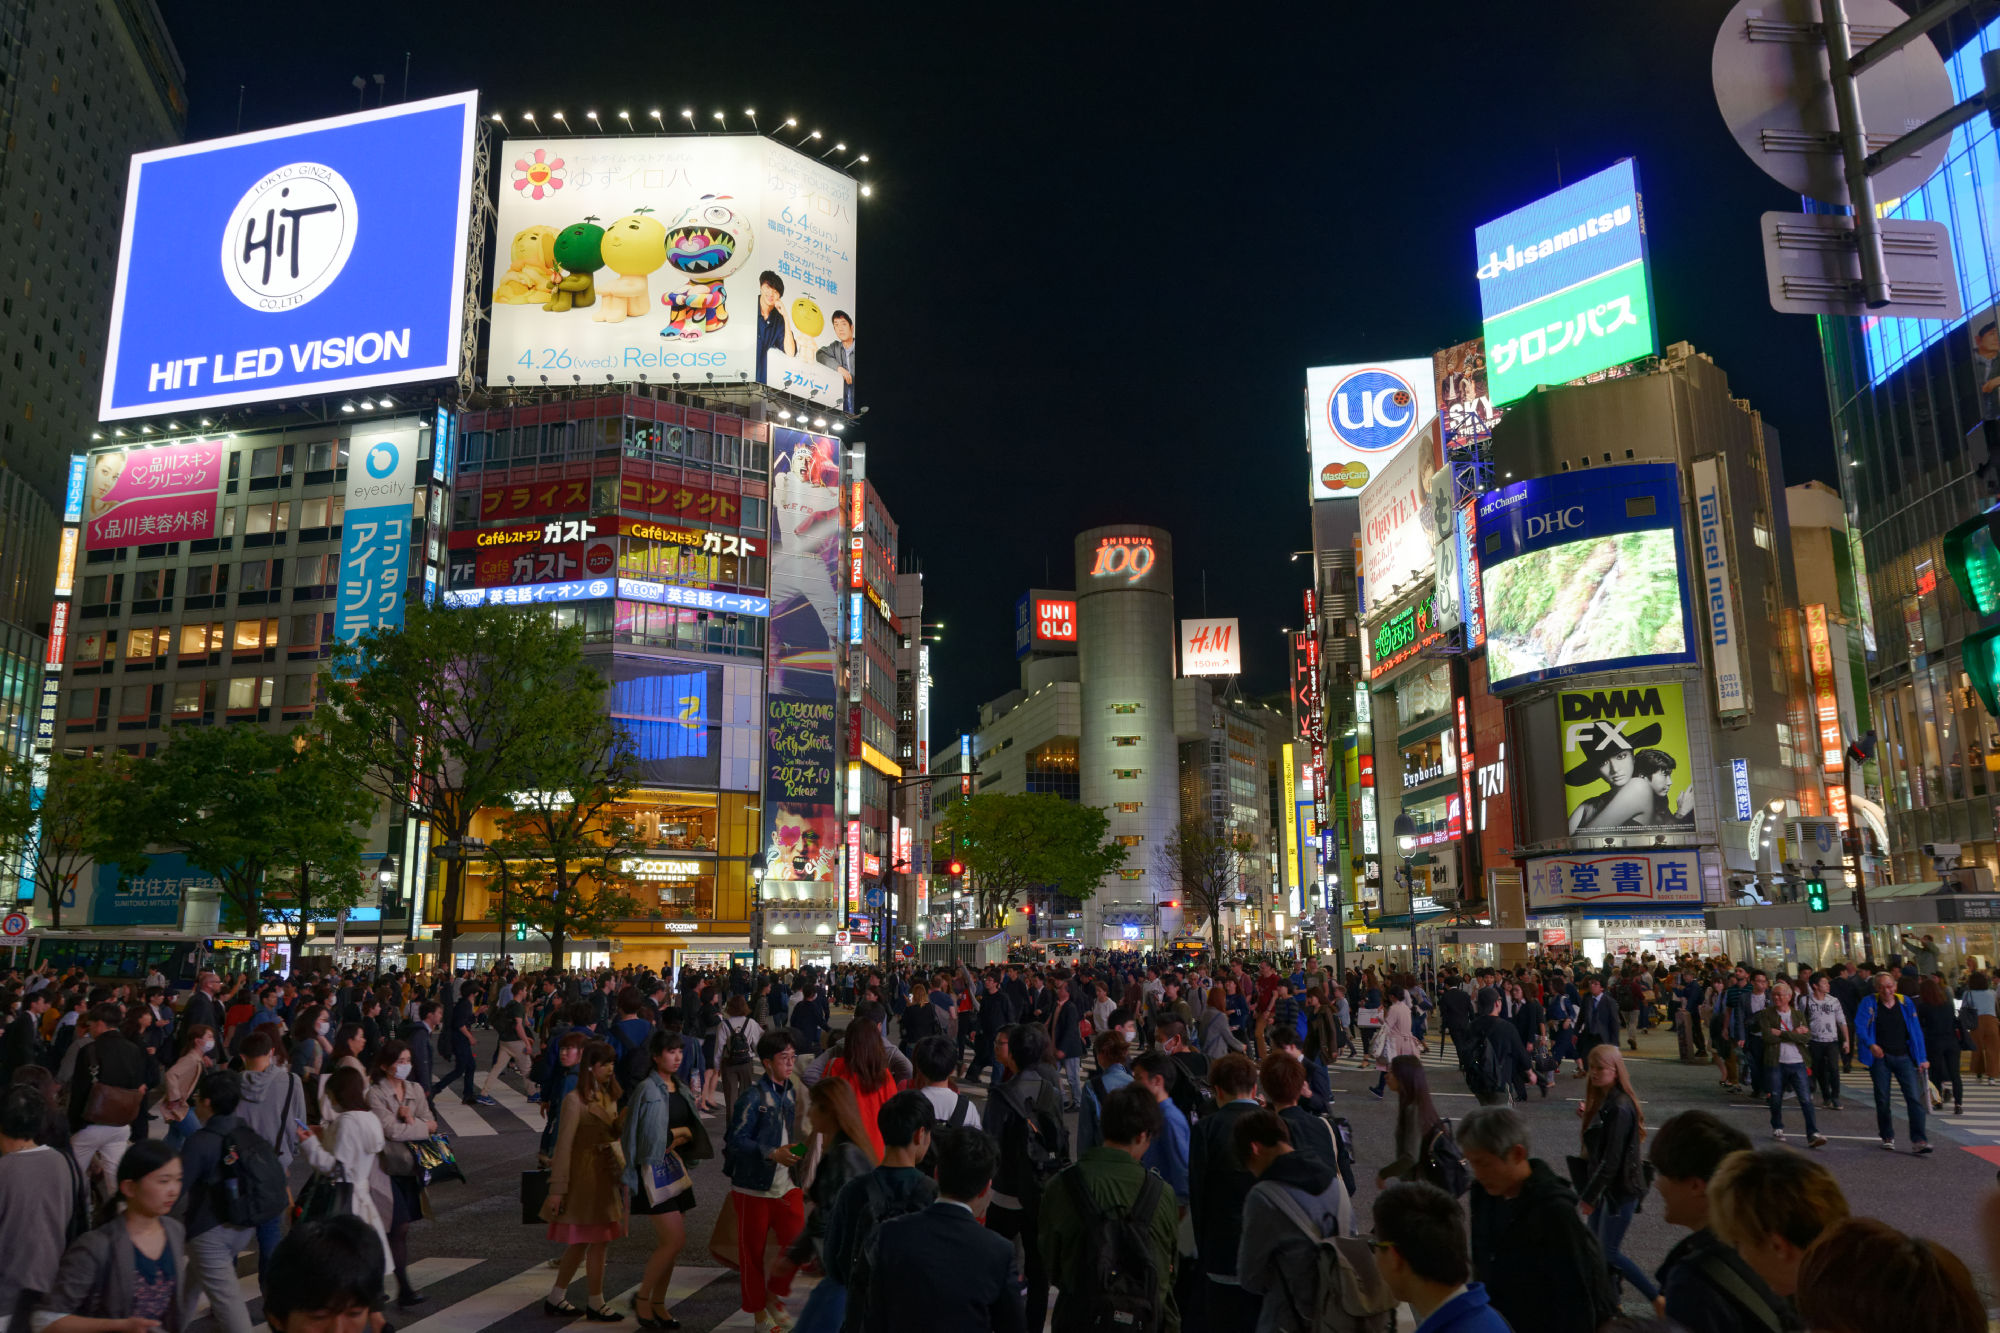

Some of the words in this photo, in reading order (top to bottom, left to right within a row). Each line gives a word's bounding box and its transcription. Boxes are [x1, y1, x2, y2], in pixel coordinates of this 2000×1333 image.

[254, 167, 293, 194] TOKYO
[299, 165, 333, 183] GINZA
[1476, 205, 1632, 280] Hisamitsu
[1490, 295, 1637, 374] サロンパス
[148, 356, 208, 392] HIT
[212, 346, 283, 384] LED
[293, 328, 411, 374] VISION
[623, 347, 727, 368] Release
[1449, 396, 1494, 430] SKY
[149, 451, 215, 472] 品川スキン
[147, 470, 206, 489] クリニック
[1321, 471, 1369, 482] MasterCard
[354, 482, 406, 503] eyecity
[483, 482, 587, 513] プライス
[621, 480, 737, 518] コンタクト
[1480, 503, 1495, 517] DHC
[1495, 489, 1528, 509] Channel
[104, 509, 208, 539] 品川美容外科
[543, 520, 597, 544] ガスト
[1526, 505, 1585, 539] DHC
[1699, 485, 1725, 570] Taisei
[703, 532, 757, 557] ガスト
[1101, 537, 1153, 546] SHIBUYA
[452, 562, 476, 581] 7F
[511, 552, 578, 584] ガスト
[1090, 544, 1155, 583] 109
[489, 583, 585, 604] 英会話イーオン
[623, 583, 659, 598] AEON
[667, 587, 767, 613] 英会話イーオン
[1041, 604, 1070, 620] UNI
[1709, 575, 1729, 646] neon
[1041, 620, 1072, 638] QLO
[1189, 625, 1232, 655] H&M
[919, 650, 928, 668] BIC
[1559, 665, 1577, 675] DHC
[918, 668, 928, 711] CAMERA
[1719, 673, 1738, 683] (03)
[1720, 682, 1739, 691] 3719
[1561, 687, 1665, 722] DMM
[1720, 690, 1740, 698] 2468
[768, 727, 798, 757] Party
[1565, 720, 1633, 753] FX
[1818, 706, 1842, 769] 三千里
[785, 780, 819, 797] Release
[1404, 762, 1442, 788] Euphoria
[1532, 861, 1689, 897] 大盛堂書店
